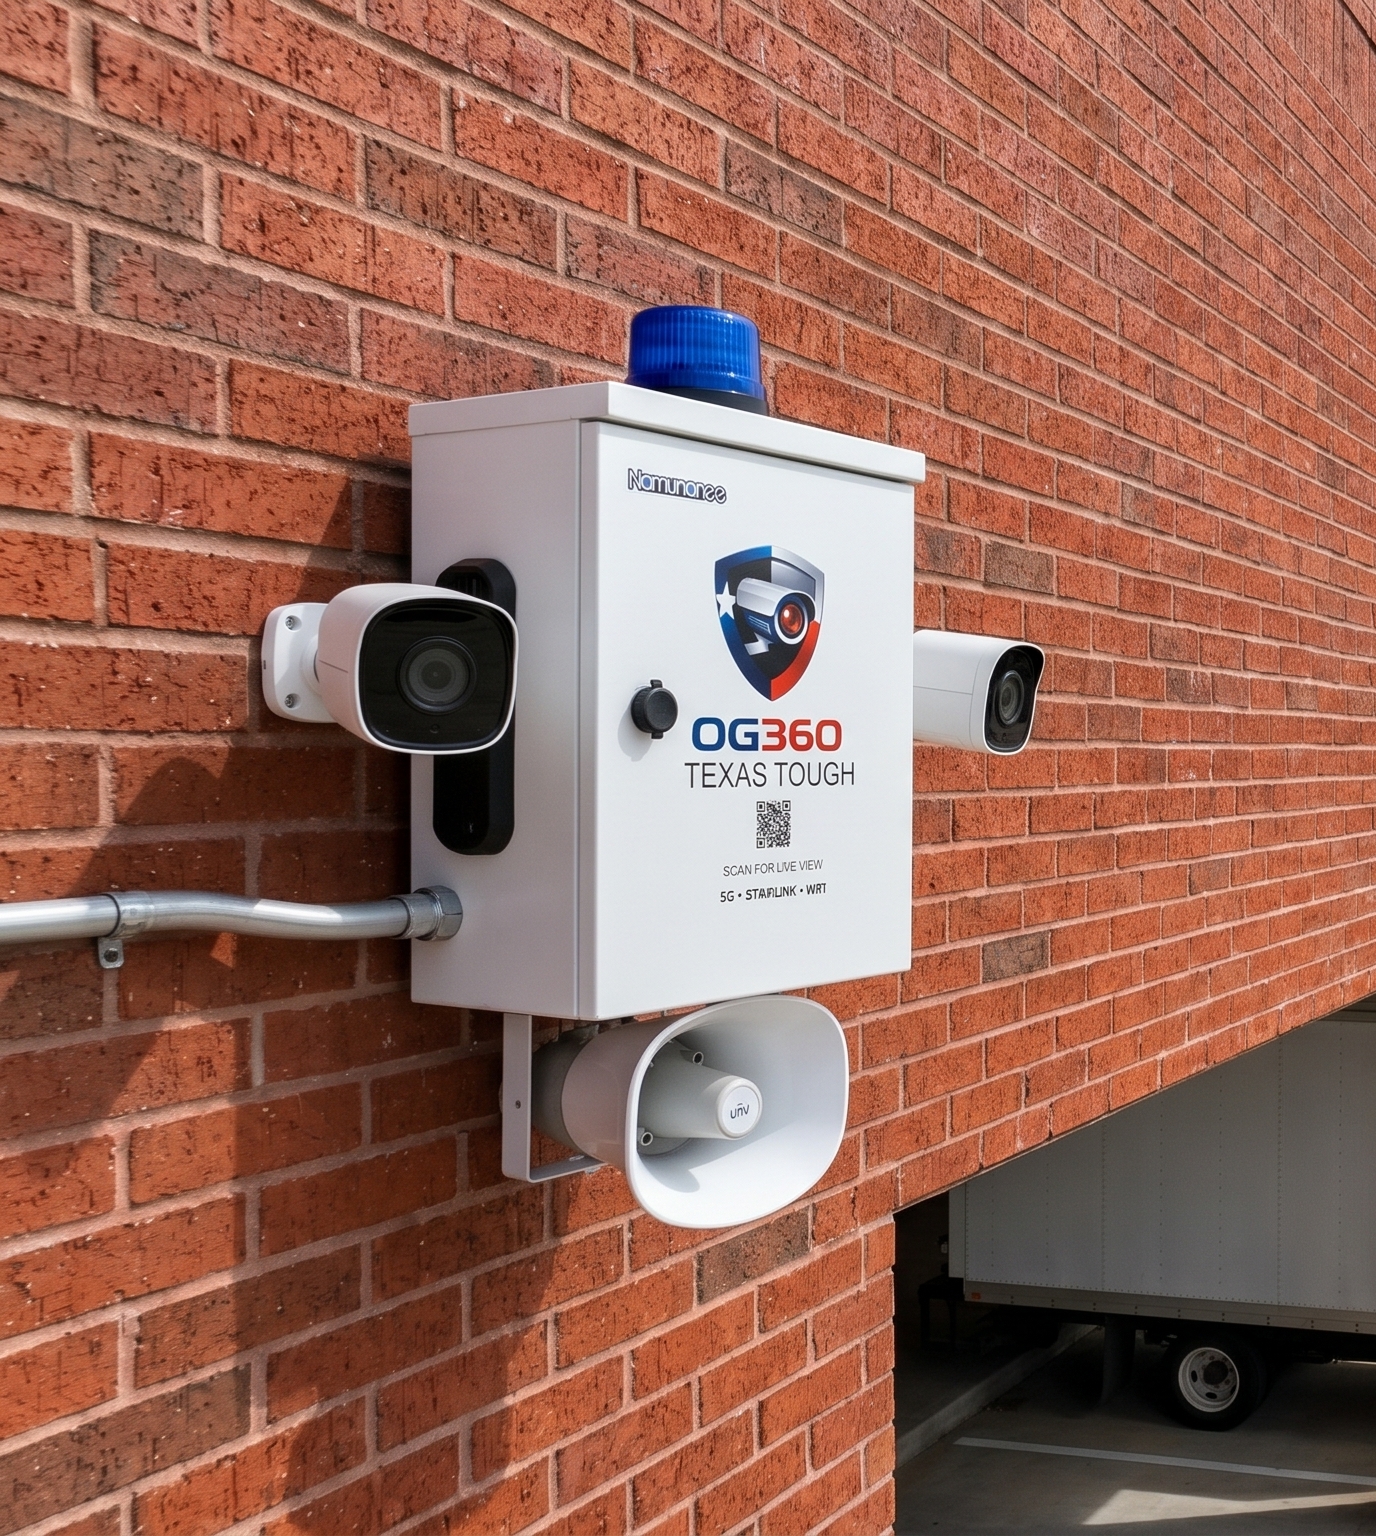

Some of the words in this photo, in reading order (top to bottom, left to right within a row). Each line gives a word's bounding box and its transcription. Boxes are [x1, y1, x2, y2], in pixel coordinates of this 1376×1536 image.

[691, 717, 843, 752] OG360
[684, 762, 767, 788] TEXAS
[774, 762, 855, 787] TOUGH
[723, 865, 752, 877] SCAN
[754, 862, 775, 875] FOR
[776, 861, 797, 873] LIVE
[799, 859, 824, 871] VIEW
[720, 890, 735, 903] 5G
